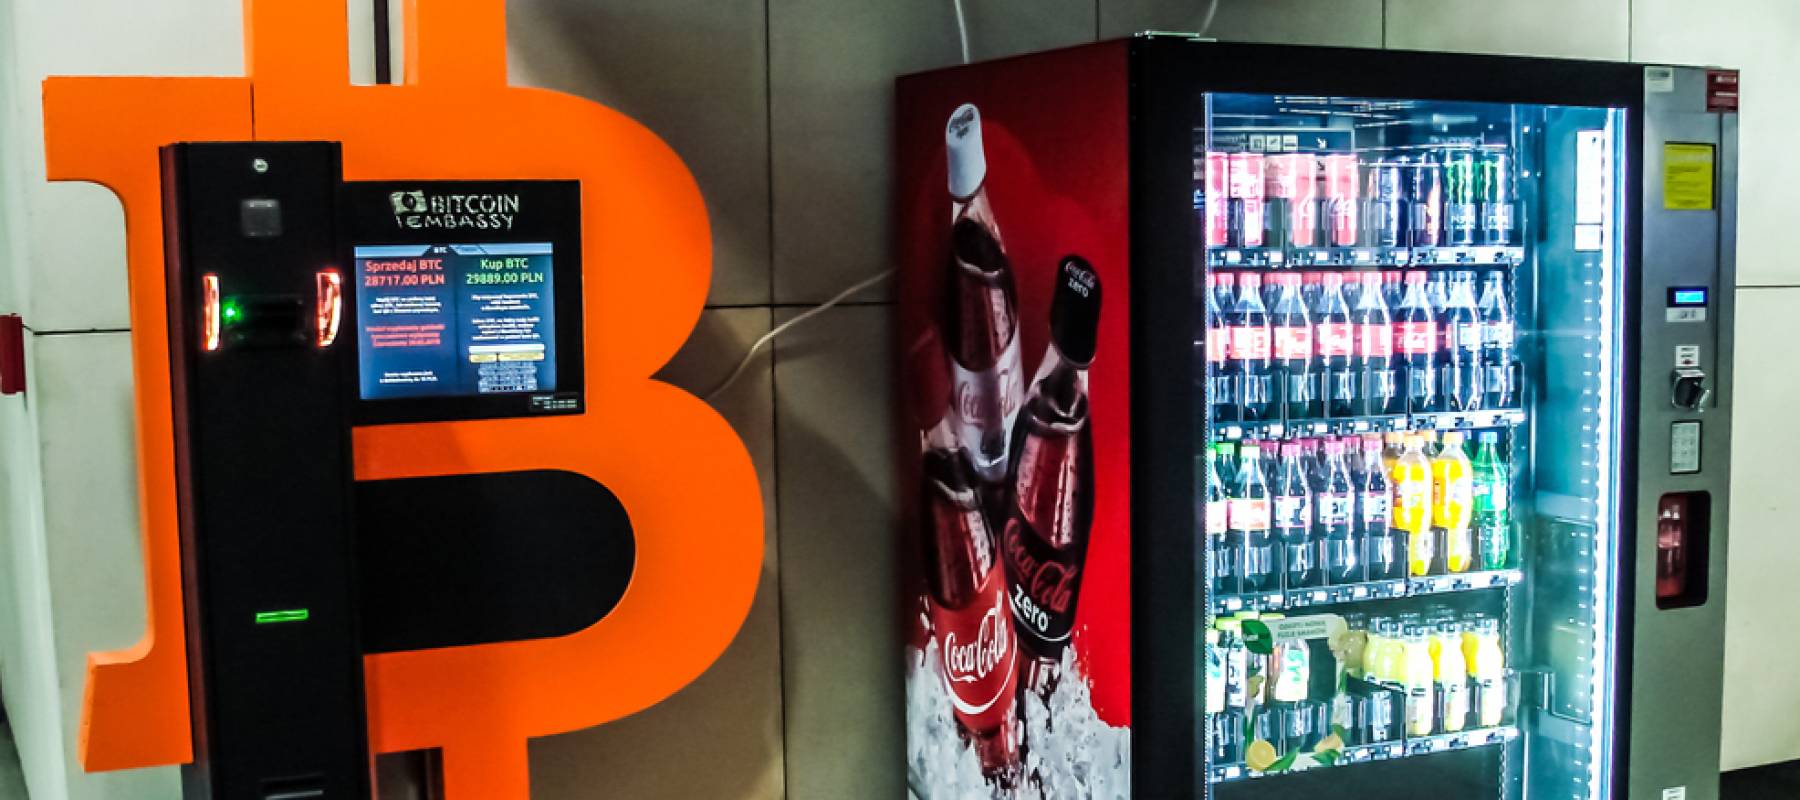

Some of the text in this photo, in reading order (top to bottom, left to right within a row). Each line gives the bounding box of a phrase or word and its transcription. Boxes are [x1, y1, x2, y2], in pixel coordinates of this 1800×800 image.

[431, 194, 520, 213] BITCOIN
[406, 214, 515, 229] EMBASSY
[365, 258, 443, 273] Sprzedaj BTC
[480, 257, 529, 271] Kup BTC
[421, 273, 445, 285] PLN
[520, 271, 544, 283] PLN
[1014, 583, 1049, 633] zero
